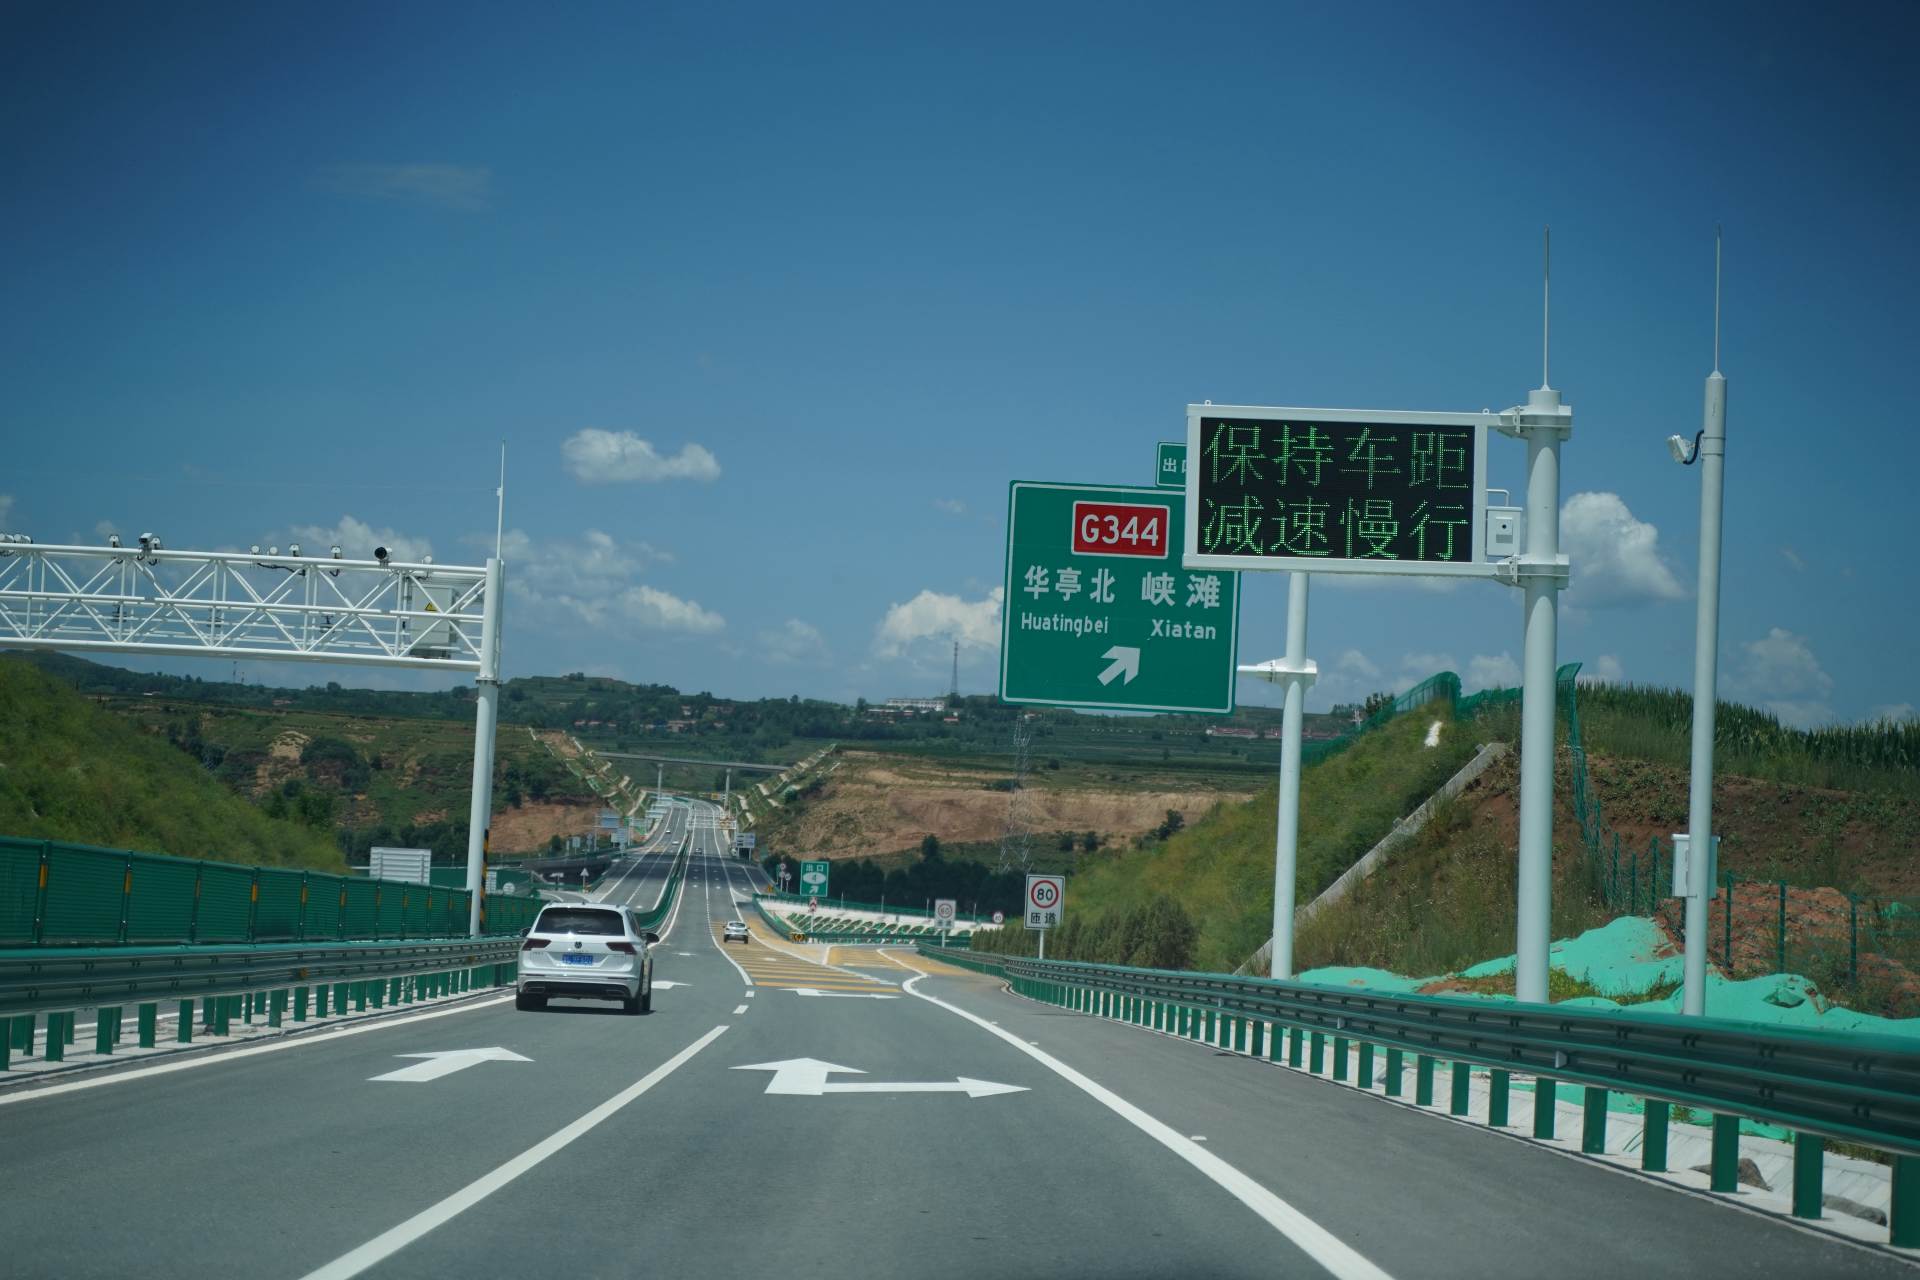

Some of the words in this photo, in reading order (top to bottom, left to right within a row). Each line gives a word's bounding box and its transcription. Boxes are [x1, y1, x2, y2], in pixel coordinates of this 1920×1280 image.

[1202, 422, 1469, 490] 保持车距
[1081, 513, 1159, 547] G344
[1201, 495, 1469, 562] 减速慢行
[1023, 565, 1116, 604] 华亭北
[1141, 571, 1221, 609] 峡滩
[1021, 612, 1109, 637] Huatingbei
[1150, 618, 1216, 640] Xiatan
[1036, 888, 1053, 901] 80
